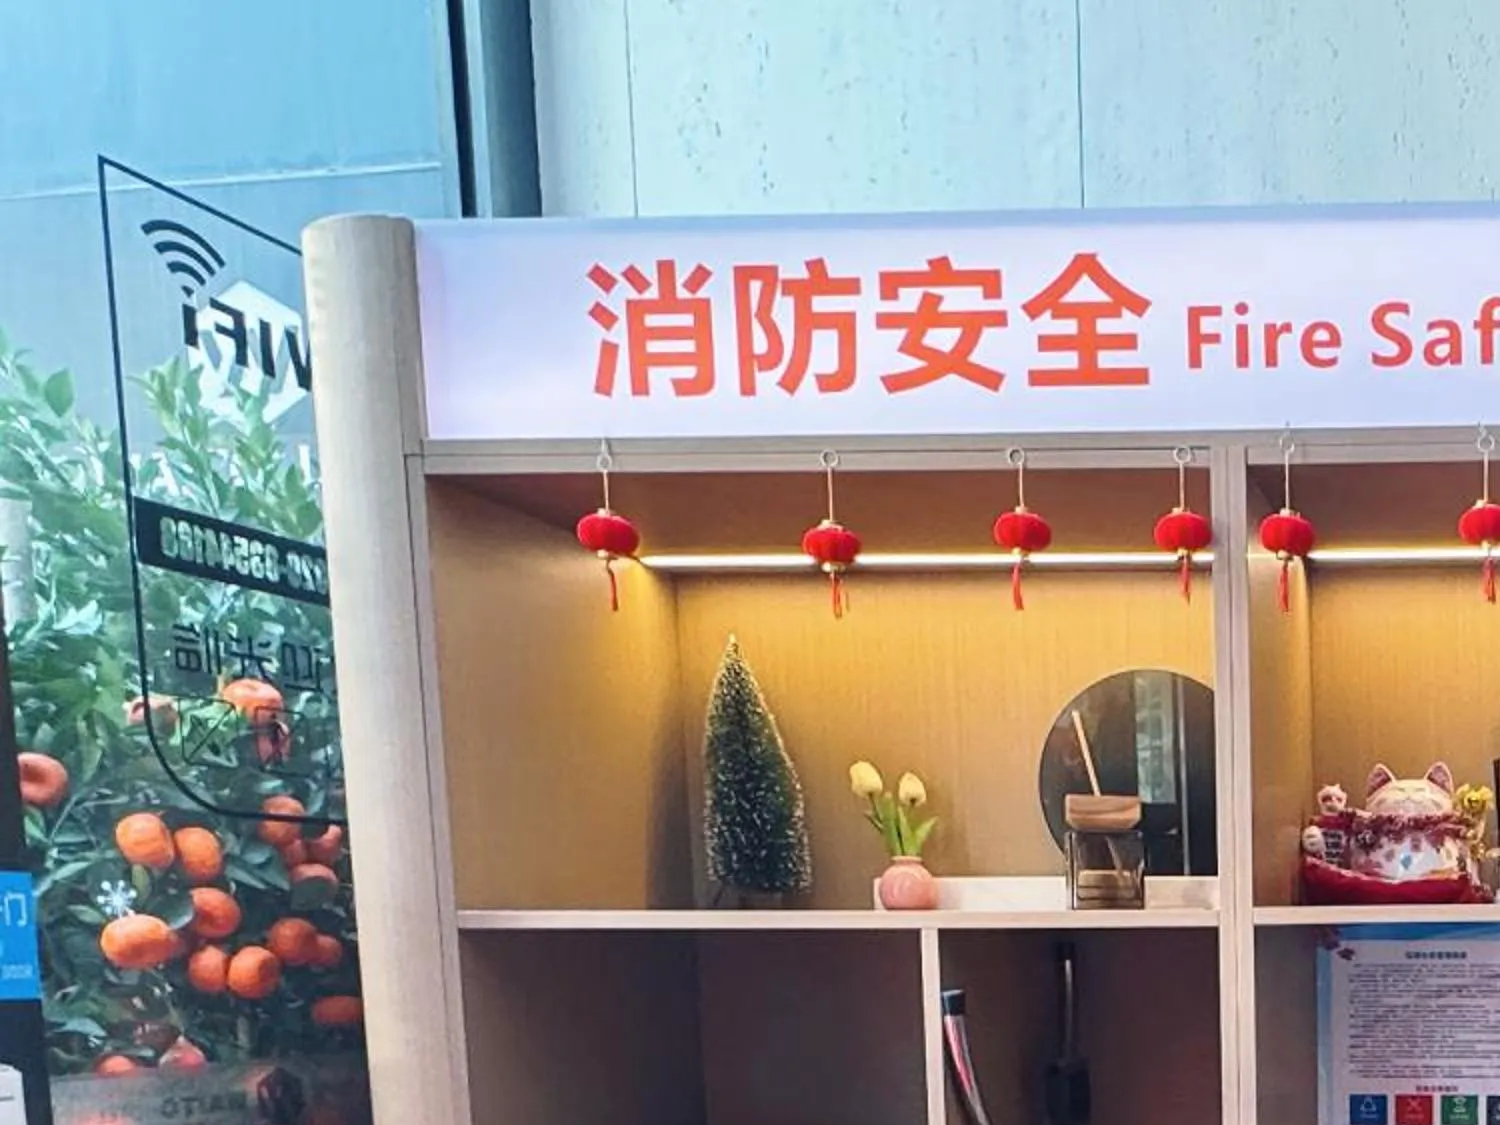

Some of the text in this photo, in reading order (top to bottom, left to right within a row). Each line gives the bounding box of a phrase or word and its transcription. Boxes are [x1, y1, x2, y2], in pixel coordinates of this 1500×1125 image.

[587, 253, 1152, 397] 消防安全
[1187, 302, 1342, 369] Fire
